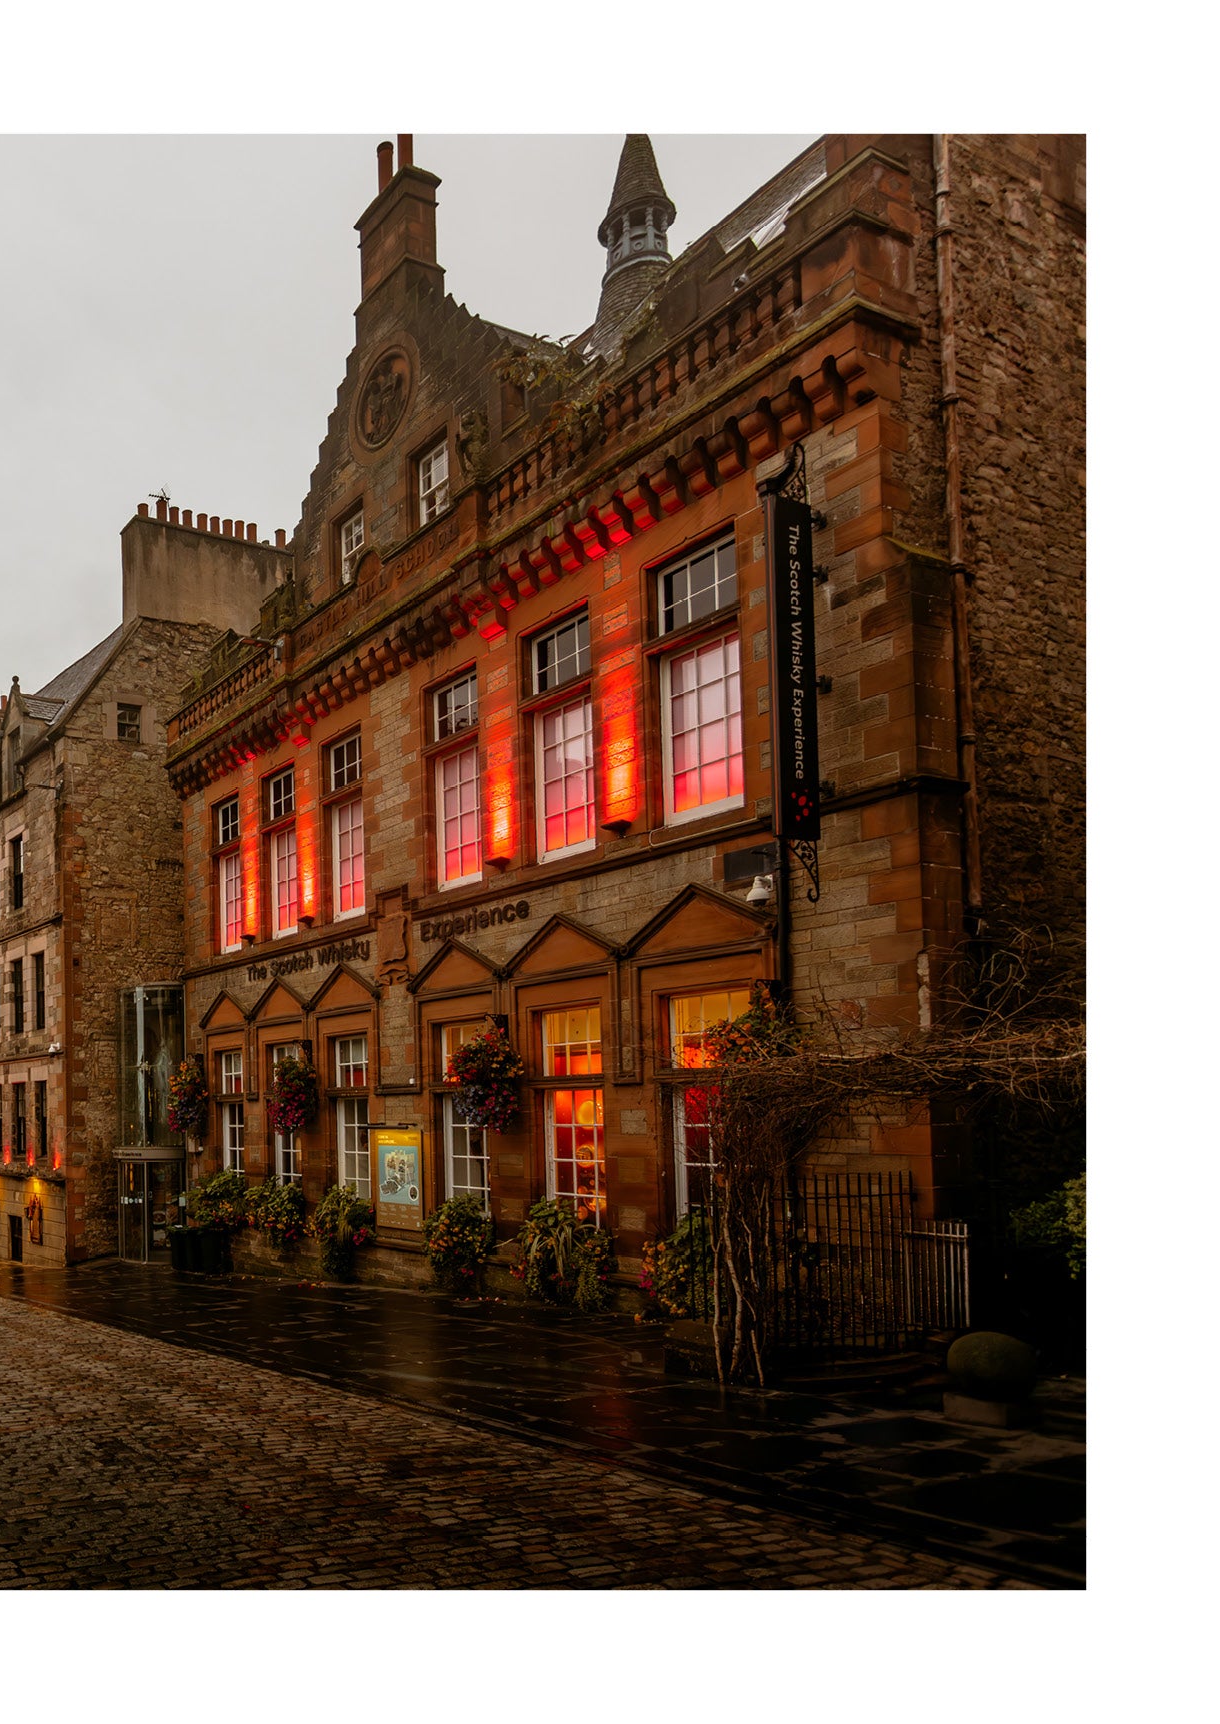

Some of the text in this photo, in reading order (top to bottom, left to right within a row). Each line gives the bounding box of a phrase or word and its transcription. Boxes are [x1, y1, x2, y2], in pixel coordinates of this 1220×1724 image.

[299, 525, 459, 649] CASTLE HILL SCHOOL
[788, 524, 805, 780] The Scotch Whisky Experience
[246, 938, 371, 982] The Scotch Whisky
[420, 900, 530, 942] Experience
